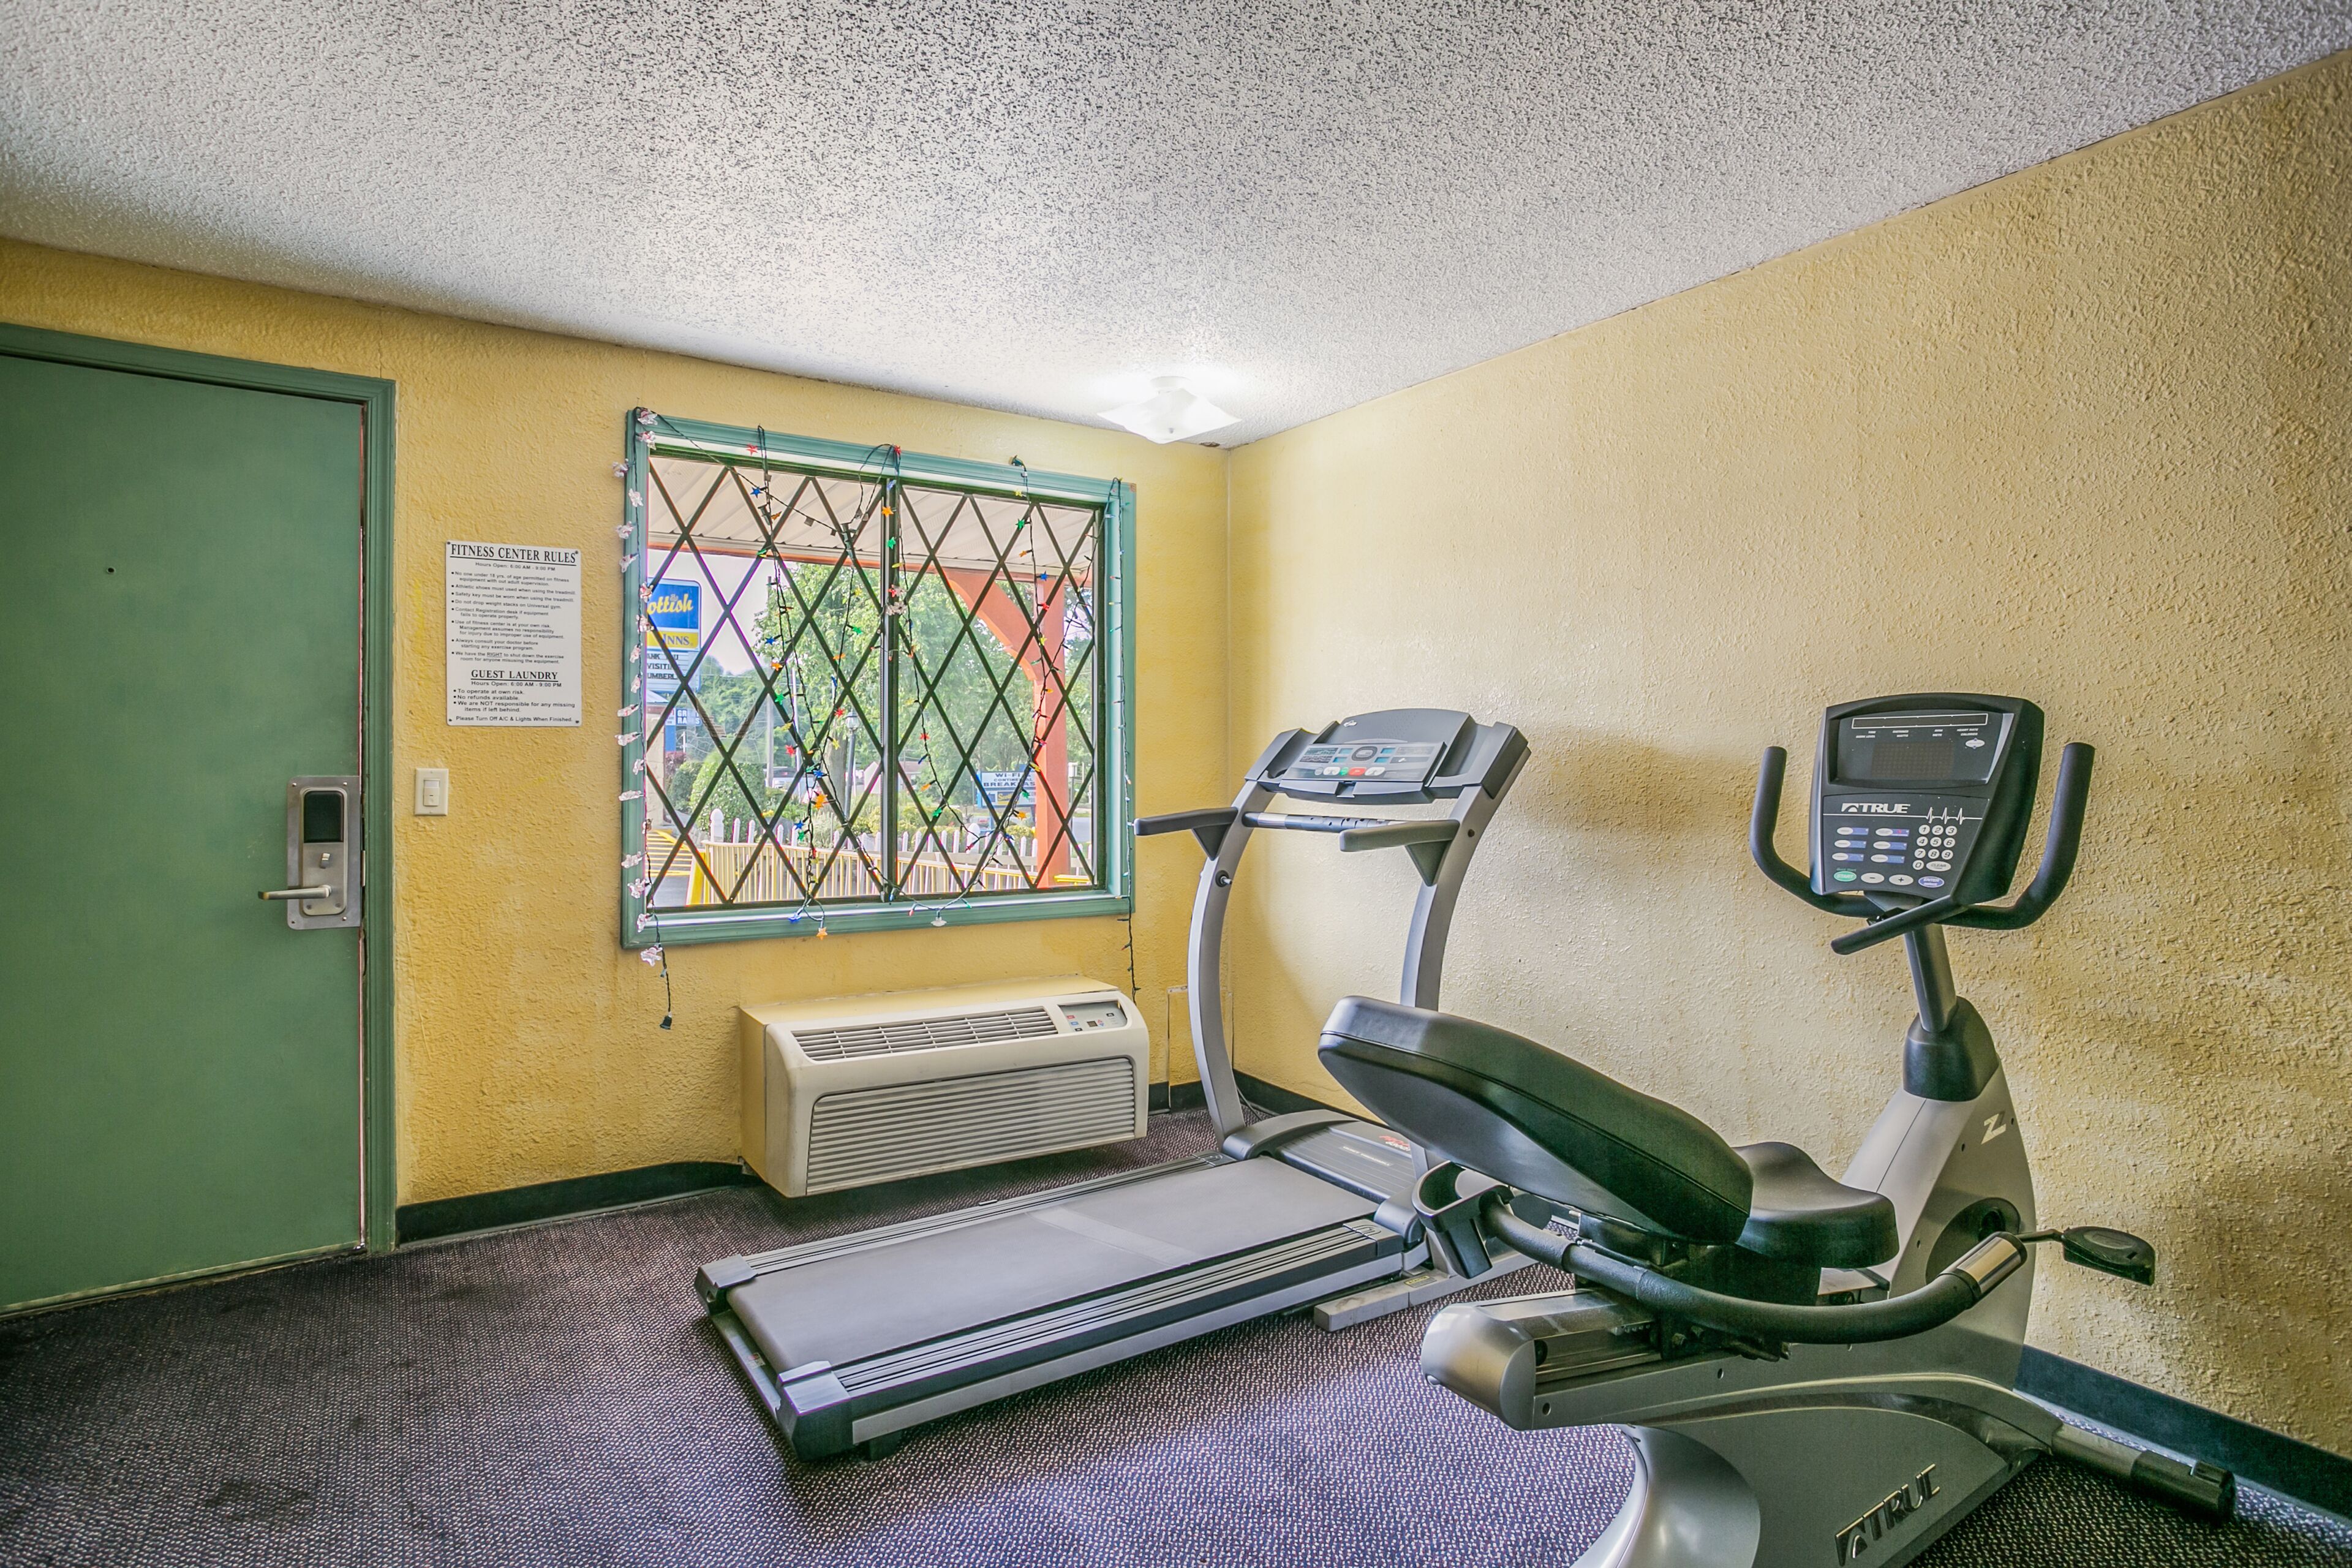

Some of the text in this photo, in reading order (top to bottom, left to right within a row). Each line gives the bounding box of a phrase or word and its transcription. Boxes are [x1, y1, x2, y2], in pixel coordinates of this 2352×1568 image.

[451, 544, 576, 563] FITNESS CENTER RULES
[471, 669, 558, 679] GUEST LAUNDRY
[1859, 803, 1910, 813] TRUE
[1863, 1463, 1940, 1541] TRUE
